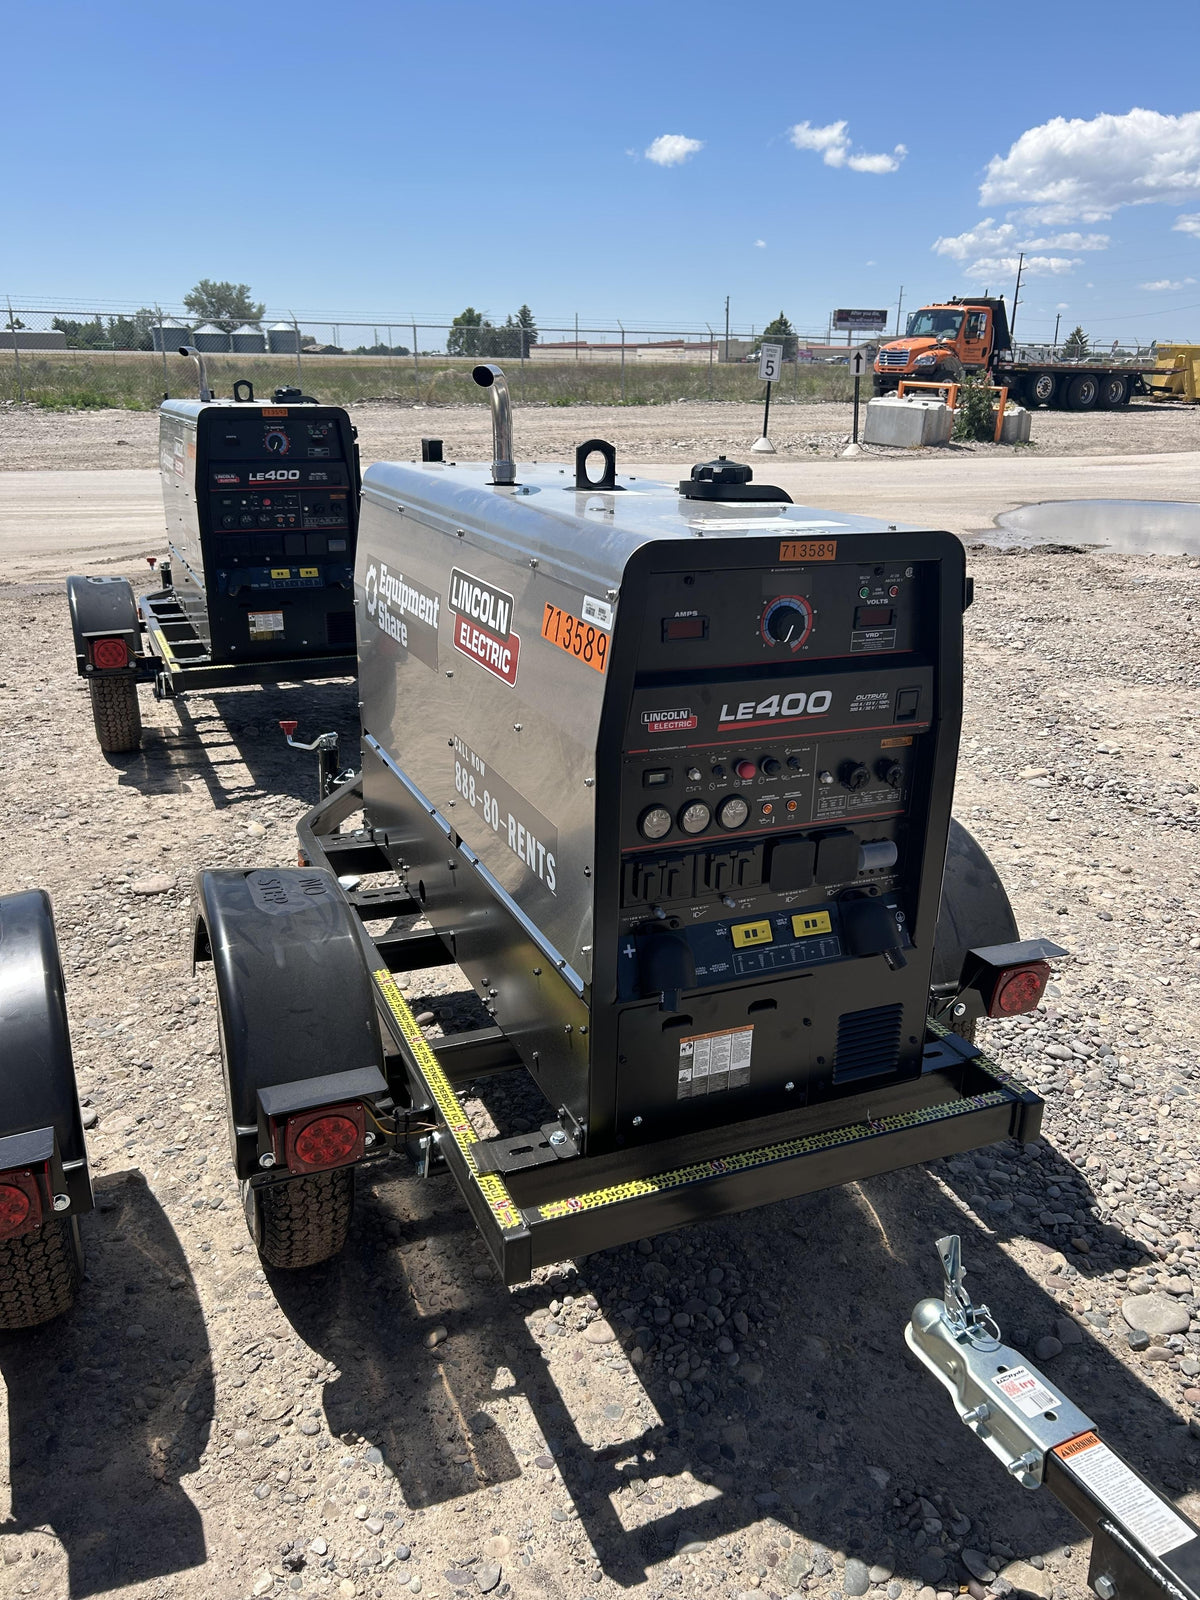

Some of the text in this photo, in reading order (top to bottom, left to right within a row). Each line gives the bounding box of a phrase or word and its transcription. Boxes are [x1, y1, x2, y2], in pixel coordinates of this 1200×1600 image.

[765, 360, 775, 377] 5
[248, 469, 300, 481] LE400
[782, 543, 834, 558] 713589
[378, 563, 440, 629] Equipment
[451, 575, 510, 635] LINCOLN
[674, 610, 698, 618] AMPS
[377, 602, 408, 648] Share
[543, 604, 608, 670] 713589
[459, 621, 511, 674] ELECTRIC
[719, 690, 833, 722] LE400
[644, 710, 688, 722] LINCOLN
[654, 720, 692, 730] ELECTRIC
[454, 736, 486, 777] CALL NOW
[454, 760, 556, 891] 888-80-RENTS
[298, 878, 327, 896] NO
[385, 984, 394, 993] DO
[390, 993, 400, 1003] NOT
[395, 1003, 409, 1022] STAND
[405, 1021, 417, 1037] HERE
[416, 1043, 425, 1052] NE
[420, 1052, 432, 1064] PAS
[428, 1064, 443, 1086] TENEZ
[437, 1085, 457, 1115] DEBOUT
[451, 1111, 462, 1123] ICI
[583, 1194, 603, 1204] DO
[605, 1187, 632, 1198] NOT
[633, 1175, 677, 1190] STAND
[678, 1166, 712, 1179] HERE
[727, 1158, 744, 1167] NE
[744, 1152, 768, 1162] PAS
[770, 1142, 807, 1155] TENEZ
[807, 1129, 856, 1146] DEBOUT
[885, 1118, 902, 1127] NO
[919, 1107, 946, 1118] PARE
[1066, 1435, 1098, 1454] WARNING
